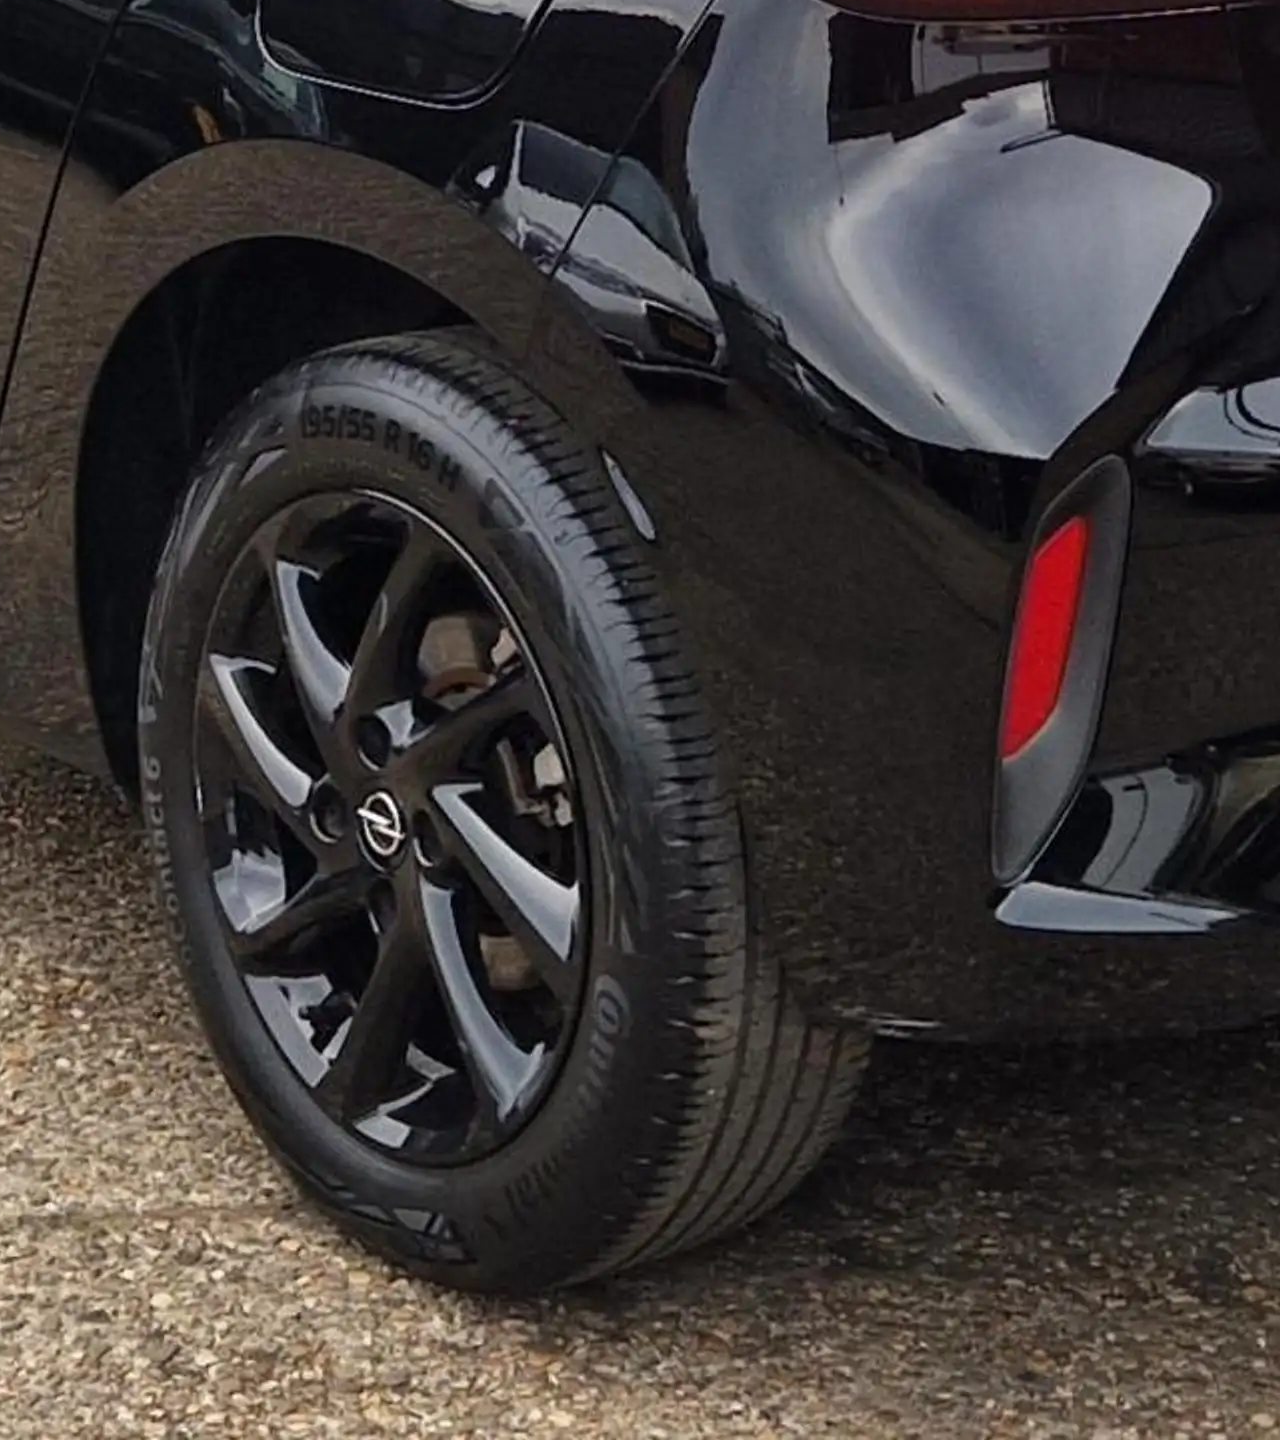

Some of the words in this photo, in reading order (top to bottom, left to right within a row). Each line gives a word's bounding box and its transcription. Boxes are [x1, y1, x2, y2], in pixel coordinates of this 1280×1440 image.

[300, 404, 376, 442] 195/55
[384, 418, 401, 453] R
[407, 431, 435, 470] 16
[437, 454, 463, 493] H
